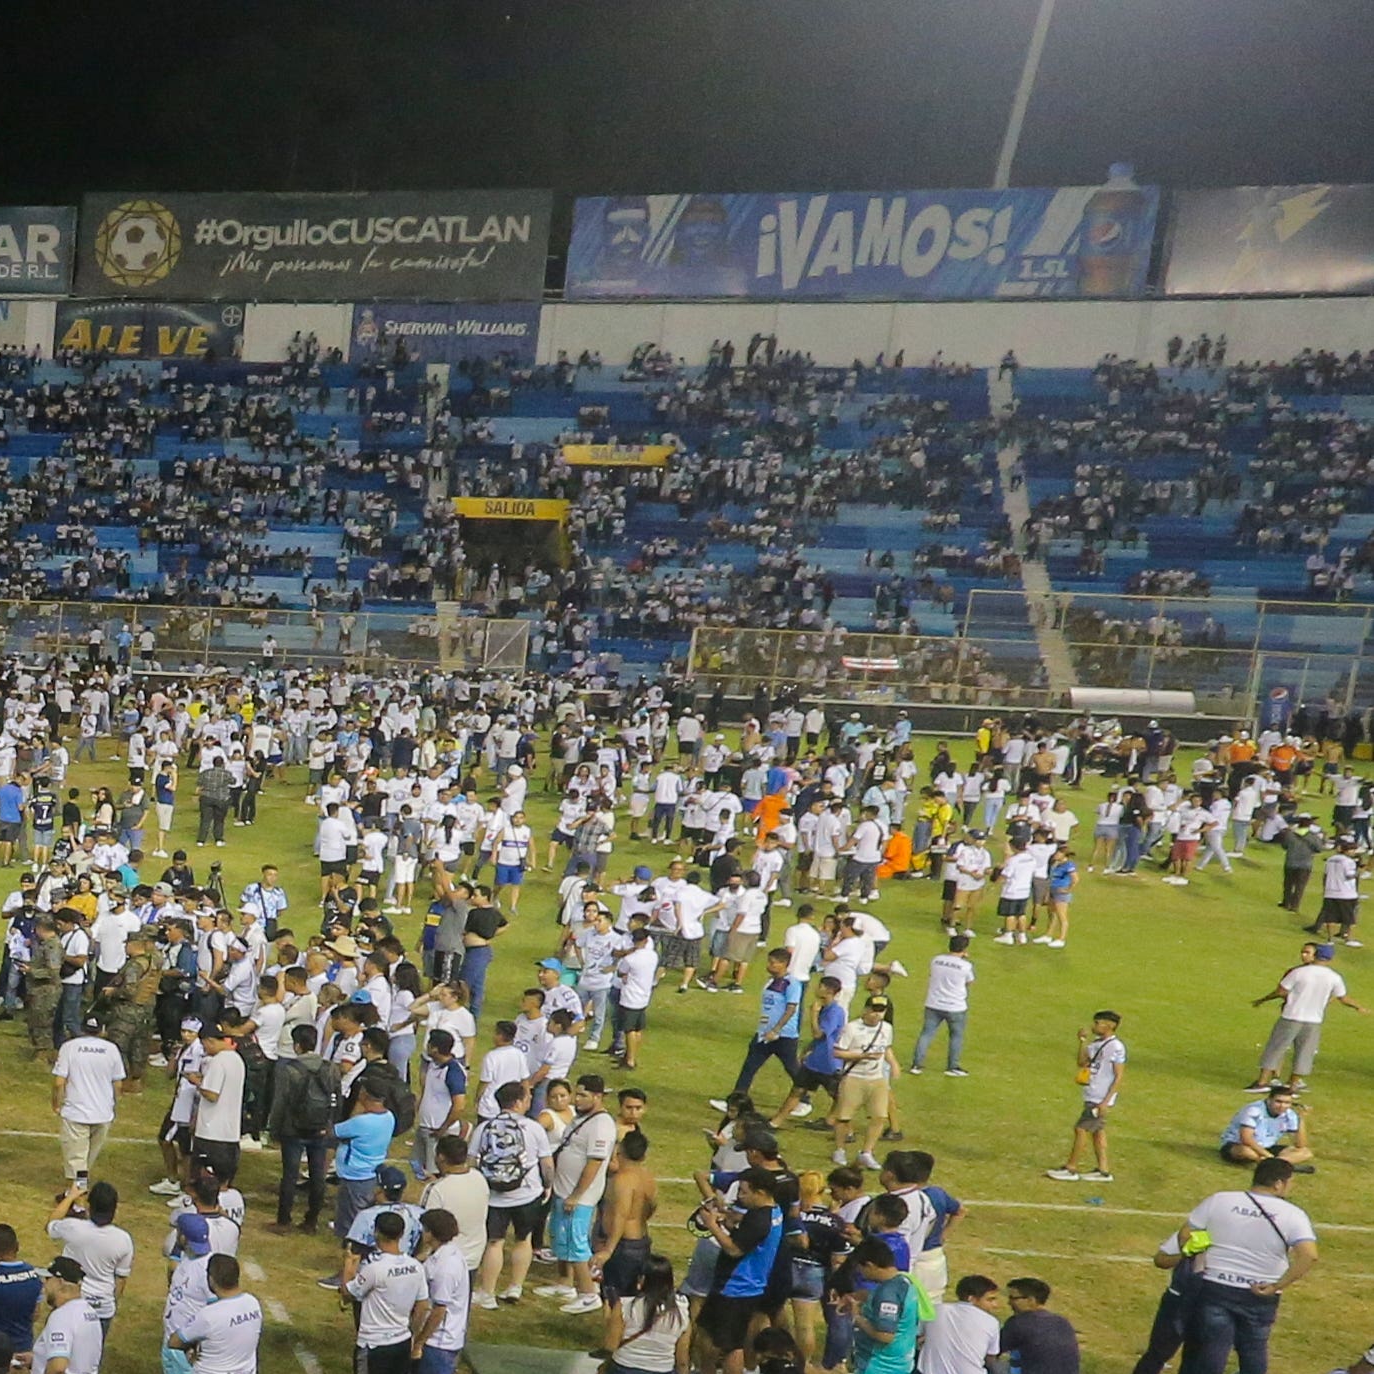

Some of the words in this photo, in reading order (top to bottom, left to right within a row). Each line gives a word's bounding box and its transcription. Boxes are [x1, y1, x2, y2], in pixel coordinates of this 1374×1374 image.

[194, 215, 531, 251] #OrgulloCUSCATLAN
[756, 194, 1015, 290] ¡VAMOS!
[484, 500, 535, 516] SALIDA
[77, 1045, 107, 1054] ABANK
[345, 1042, 355, 1053] G
[799, 1211, 832, 1227] BANK
[387, 1265, 417, 1278] ABANK
[229, 1309, 259, 1328] ABANK
